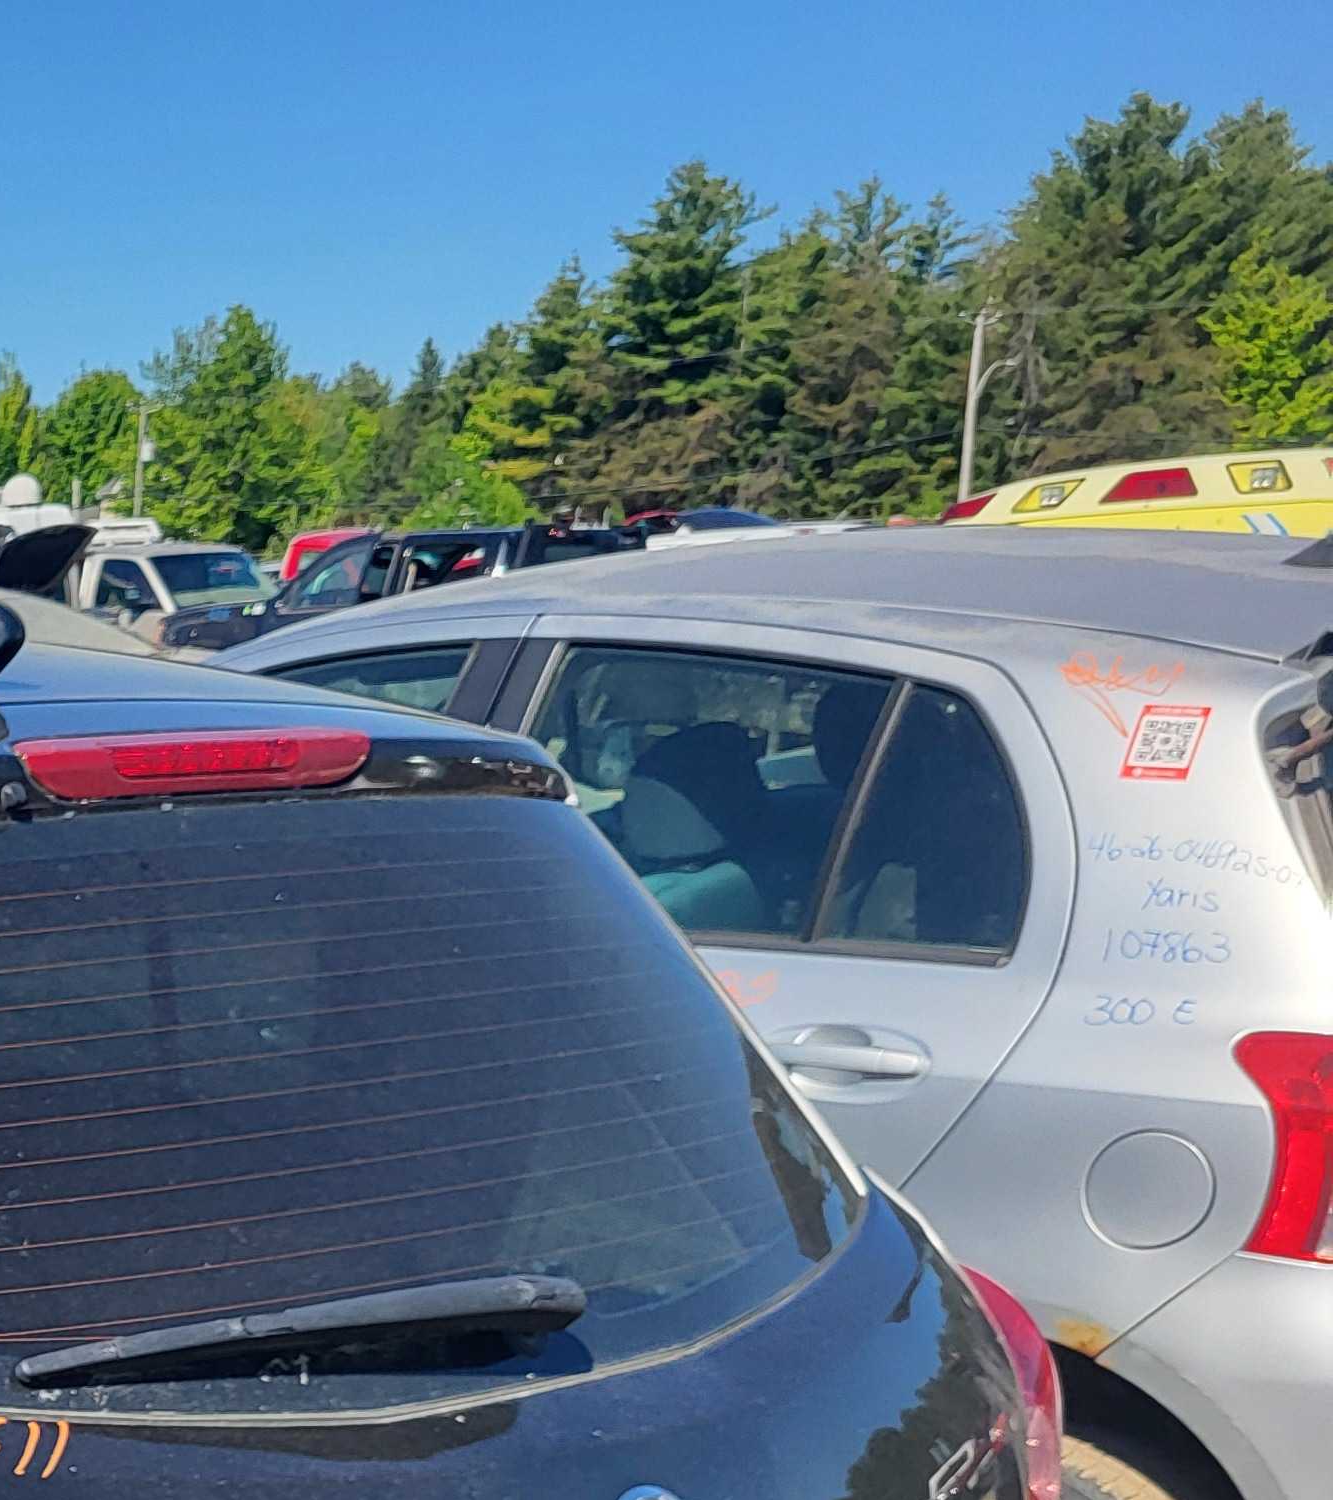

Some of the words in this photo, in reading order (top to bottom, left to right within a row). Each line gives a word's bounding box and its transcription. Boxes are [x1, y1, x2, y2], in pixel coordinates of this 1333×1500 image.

[1139, 875, 1221, 914] Yaris
[1102, 927, 1232, 964] 107863
[1083, 993, 1156, 1027] 300
